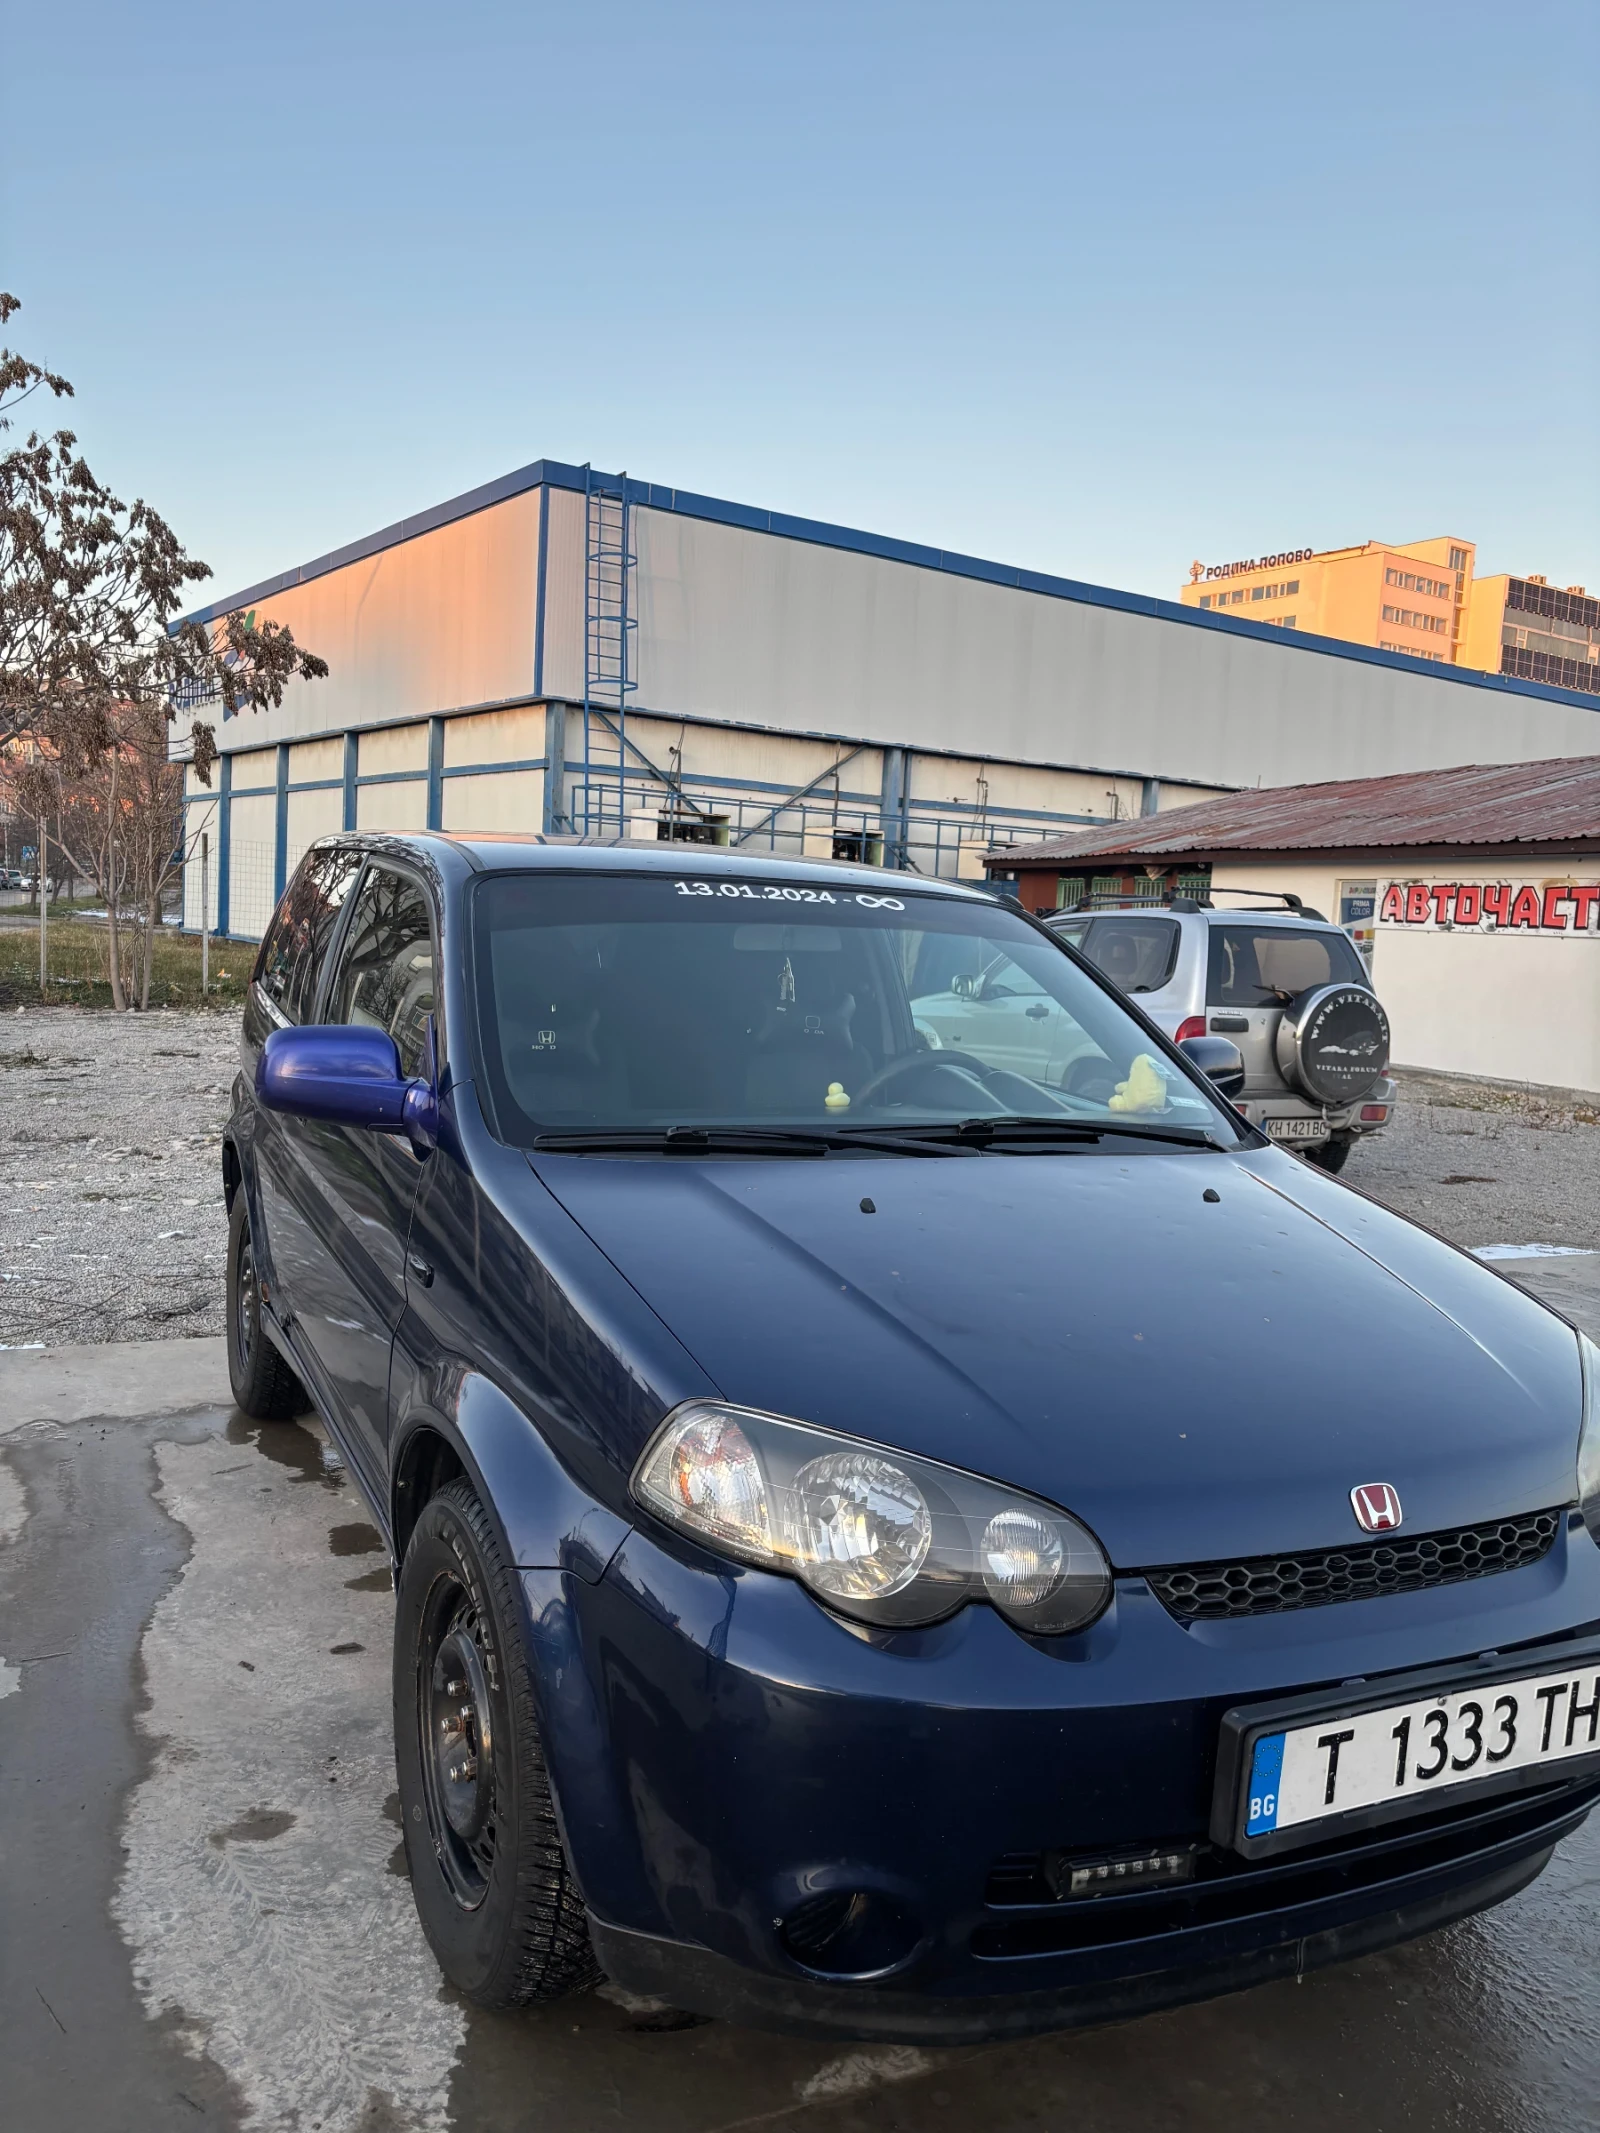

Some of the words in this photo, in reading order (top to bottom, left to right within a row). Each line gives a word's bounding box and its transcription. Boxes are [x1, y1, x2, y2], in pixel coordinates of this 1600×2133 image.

[1206, 548, 1313, 579] РОДИНА-ПОПОВО
[675, 881, 836, 904] 13.01.2024
[1350, 907, 1371, 916] COLOR
[1352, 899, 1370, 907] PRIMA
[1316, 1064, 1348, 1072] VITARA
[1286, 1121, 1311, 1136] 1421
[1317, 1729, 1354, 1805] T
[1391, 1695, 1518, 1787] 1333
[1535, 1676, 1600, 1752] TH
[1250, 1794, 1275, 1820] BG
